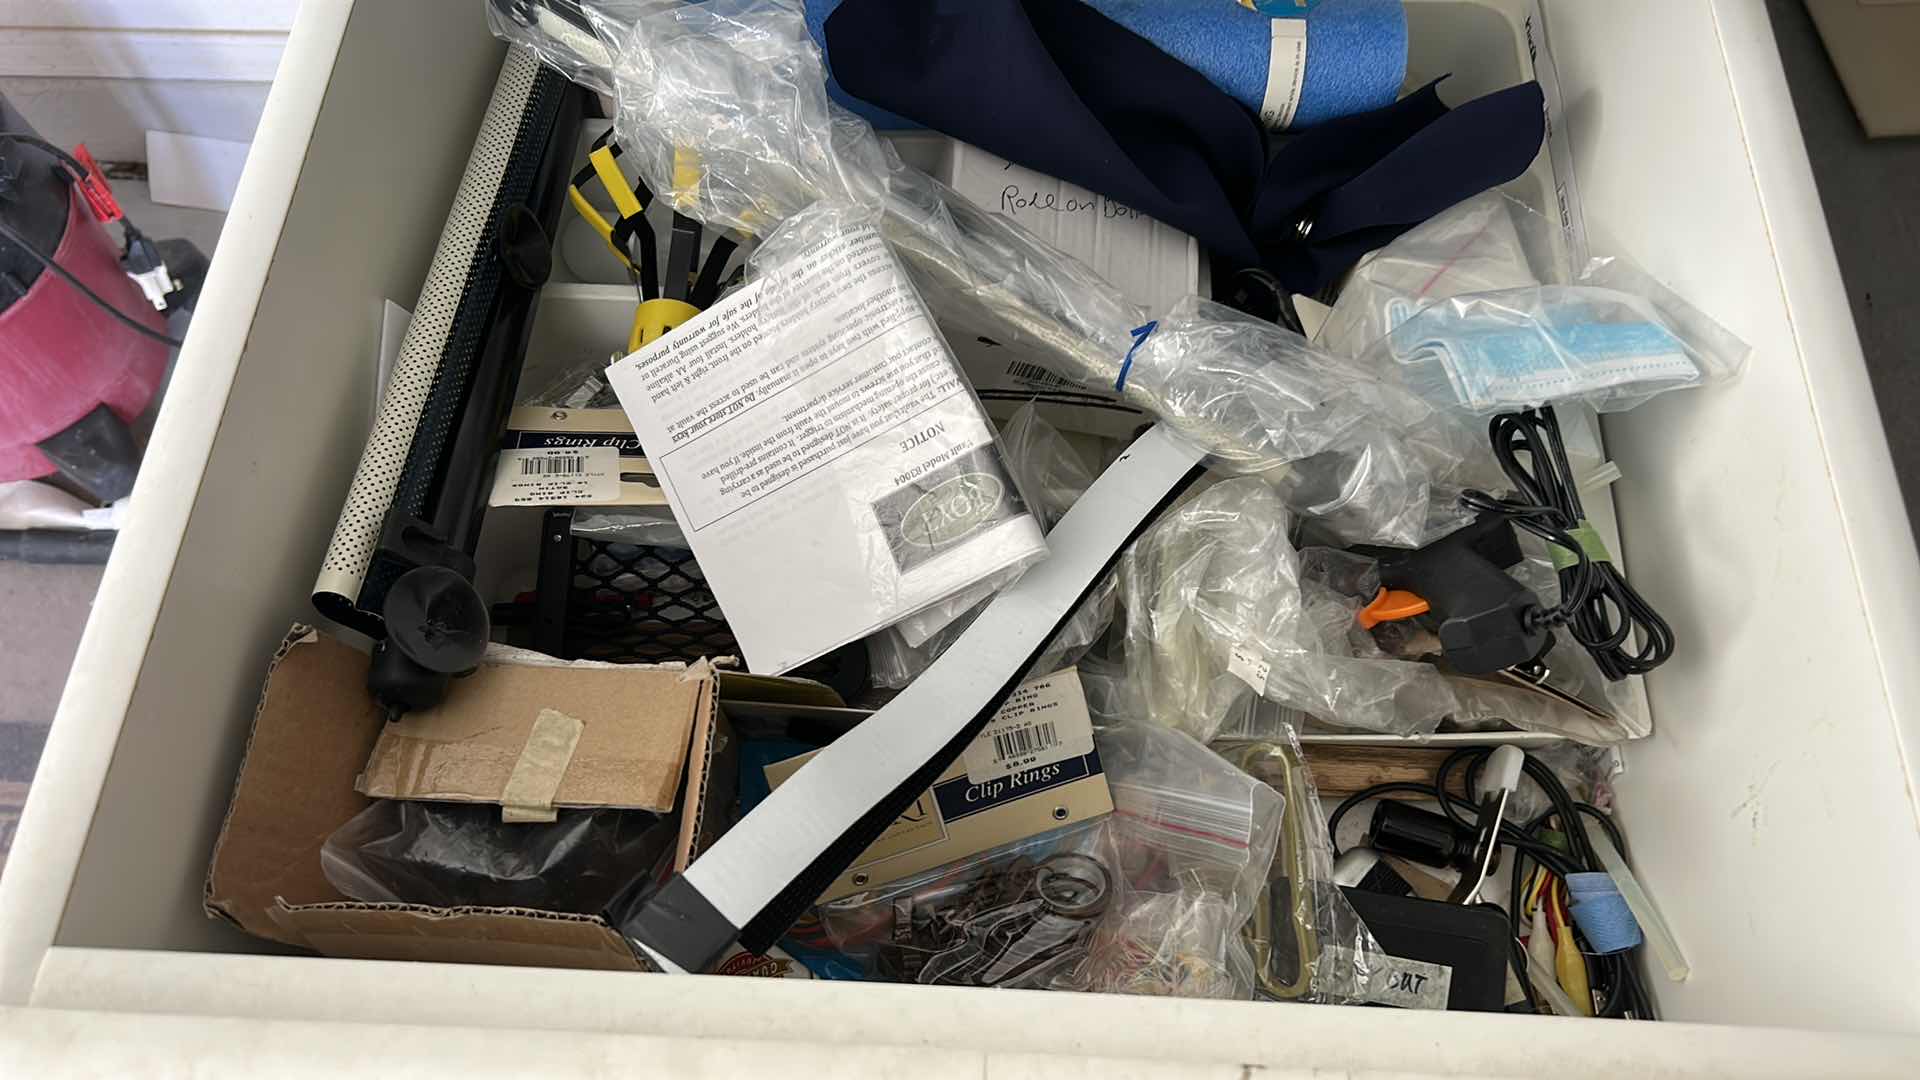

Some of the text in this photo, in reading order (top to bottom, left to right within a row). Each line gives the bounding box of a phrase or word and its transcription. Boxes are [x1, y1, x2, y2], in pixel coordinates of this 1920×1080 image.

[739, 298, 753, 310] the
[721, 307, 737, 321] safe
[707, 315, 720, 329] for
[725, 320, 740, 332] We
[671, 326, 706, 350] warranty
[698, 327, 725, 347] suggest
[741, 339, 752, 349] on
[677, 343, 699, 359] using
[704, 341, 728, 359] Install
[728, 346, 742, 357] the
[649, 355, 680, 377] Duracell
[688, 354, 704, 368] four
[640, 371, 650, 381] or
[690, 365, 709, 380] right
[758, 371, 770, 381] be
[646, 372, 674, 391] alkaline
[670, 380, 684, 392] left
[683, 376, 690, 384] &
[740, 377, 758, 393] used
[859, 375, 885, 393] screws
[651, 387, 670, 403] hand
[731, 388, 740, 396] to
[742, 391, 755, 403] Do
[708, 393, 730, 409] access
[725, 398, 744, 414] NOT
[695, 406, 708, 417] the
[705, 407, 726, 423] store
[832, 395, 875, 422] mechanism
[675, 414, 695, 428] vault
[687, 418, 707, 434] your
[793, 415, 813, 430] vault
[823, 418, 833, 427] to
[666, 424, 675, 433] at
[671, 428, 689, 443] keys
[774, 425, 794, 440] from
[543, 436, 640, 449] Clip Rings
[762, 435, 776, 446] the
[786, 439, 795, 447] It
[800, 431, 834, 454] designed
[899, 422, 944, 452] NOTICE
[756, 442, 787, 463] contains
[781, 454, 792, 463] be
[791, 449, 801, 457] to
[797, 442, 836, 469] purchased
[718, 456, 733, 470] you
[763, 459, 782, 474] used
[790, 463, 798, 472] is
[921, 451, 949, 471] Model
[701, 466, 720, 480] have
[719, 457, 757, 484] pre-drilled
[755, 468, 764, 477] as
[719, 475, 751, 495] carrying
[759, 467, 790, 489] designed
[740, 488, 752, 498] be
[750, 484, 760, 492] to
[965, 763, 1060, 803] Clip Rings
